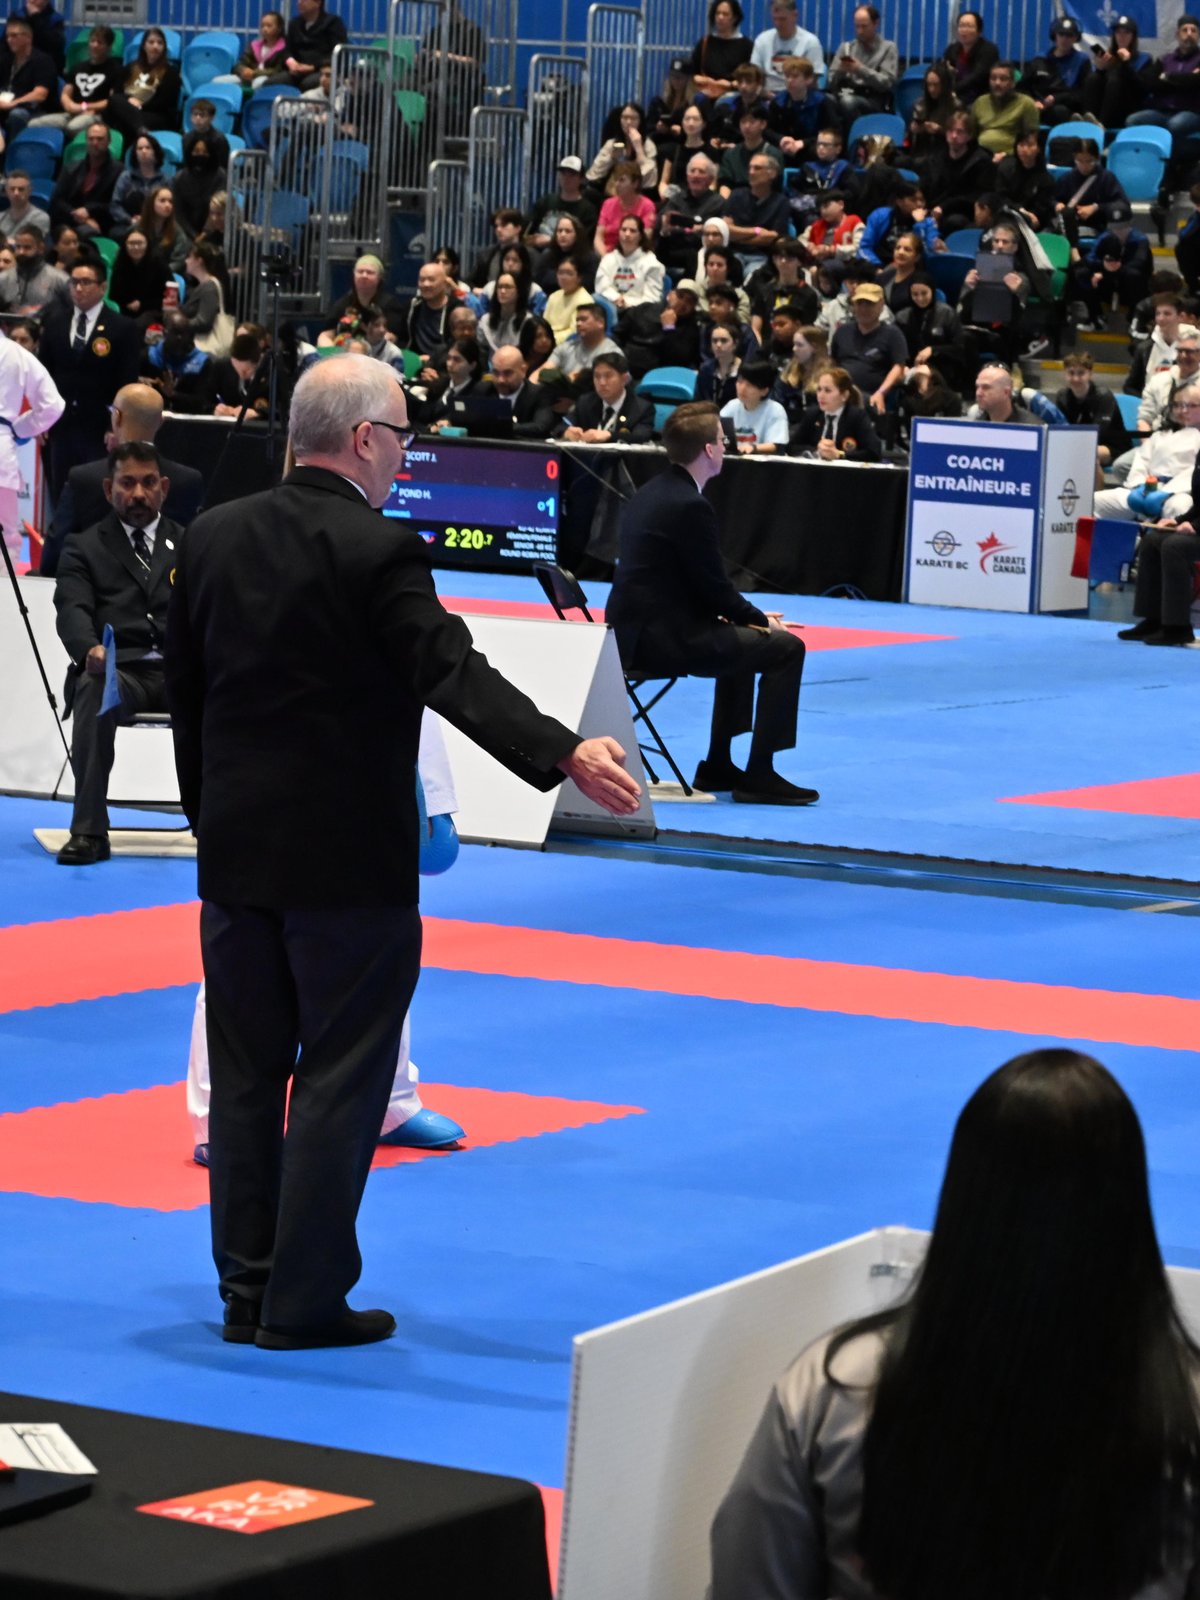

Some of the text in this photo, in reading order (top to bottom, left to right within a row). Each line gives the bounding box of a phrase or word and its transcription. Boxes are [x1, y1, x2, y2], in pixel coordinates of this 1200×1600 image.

[546, 460, 558, 479] 0
[947, 455, 1004, 471] COACH
[546, 497, 555, 517] 1
[916, 558, 969, 570] KARATE BC
[993, 556, 1026, 566] KARATE
[993, 565, 1026, 575] CANADA
